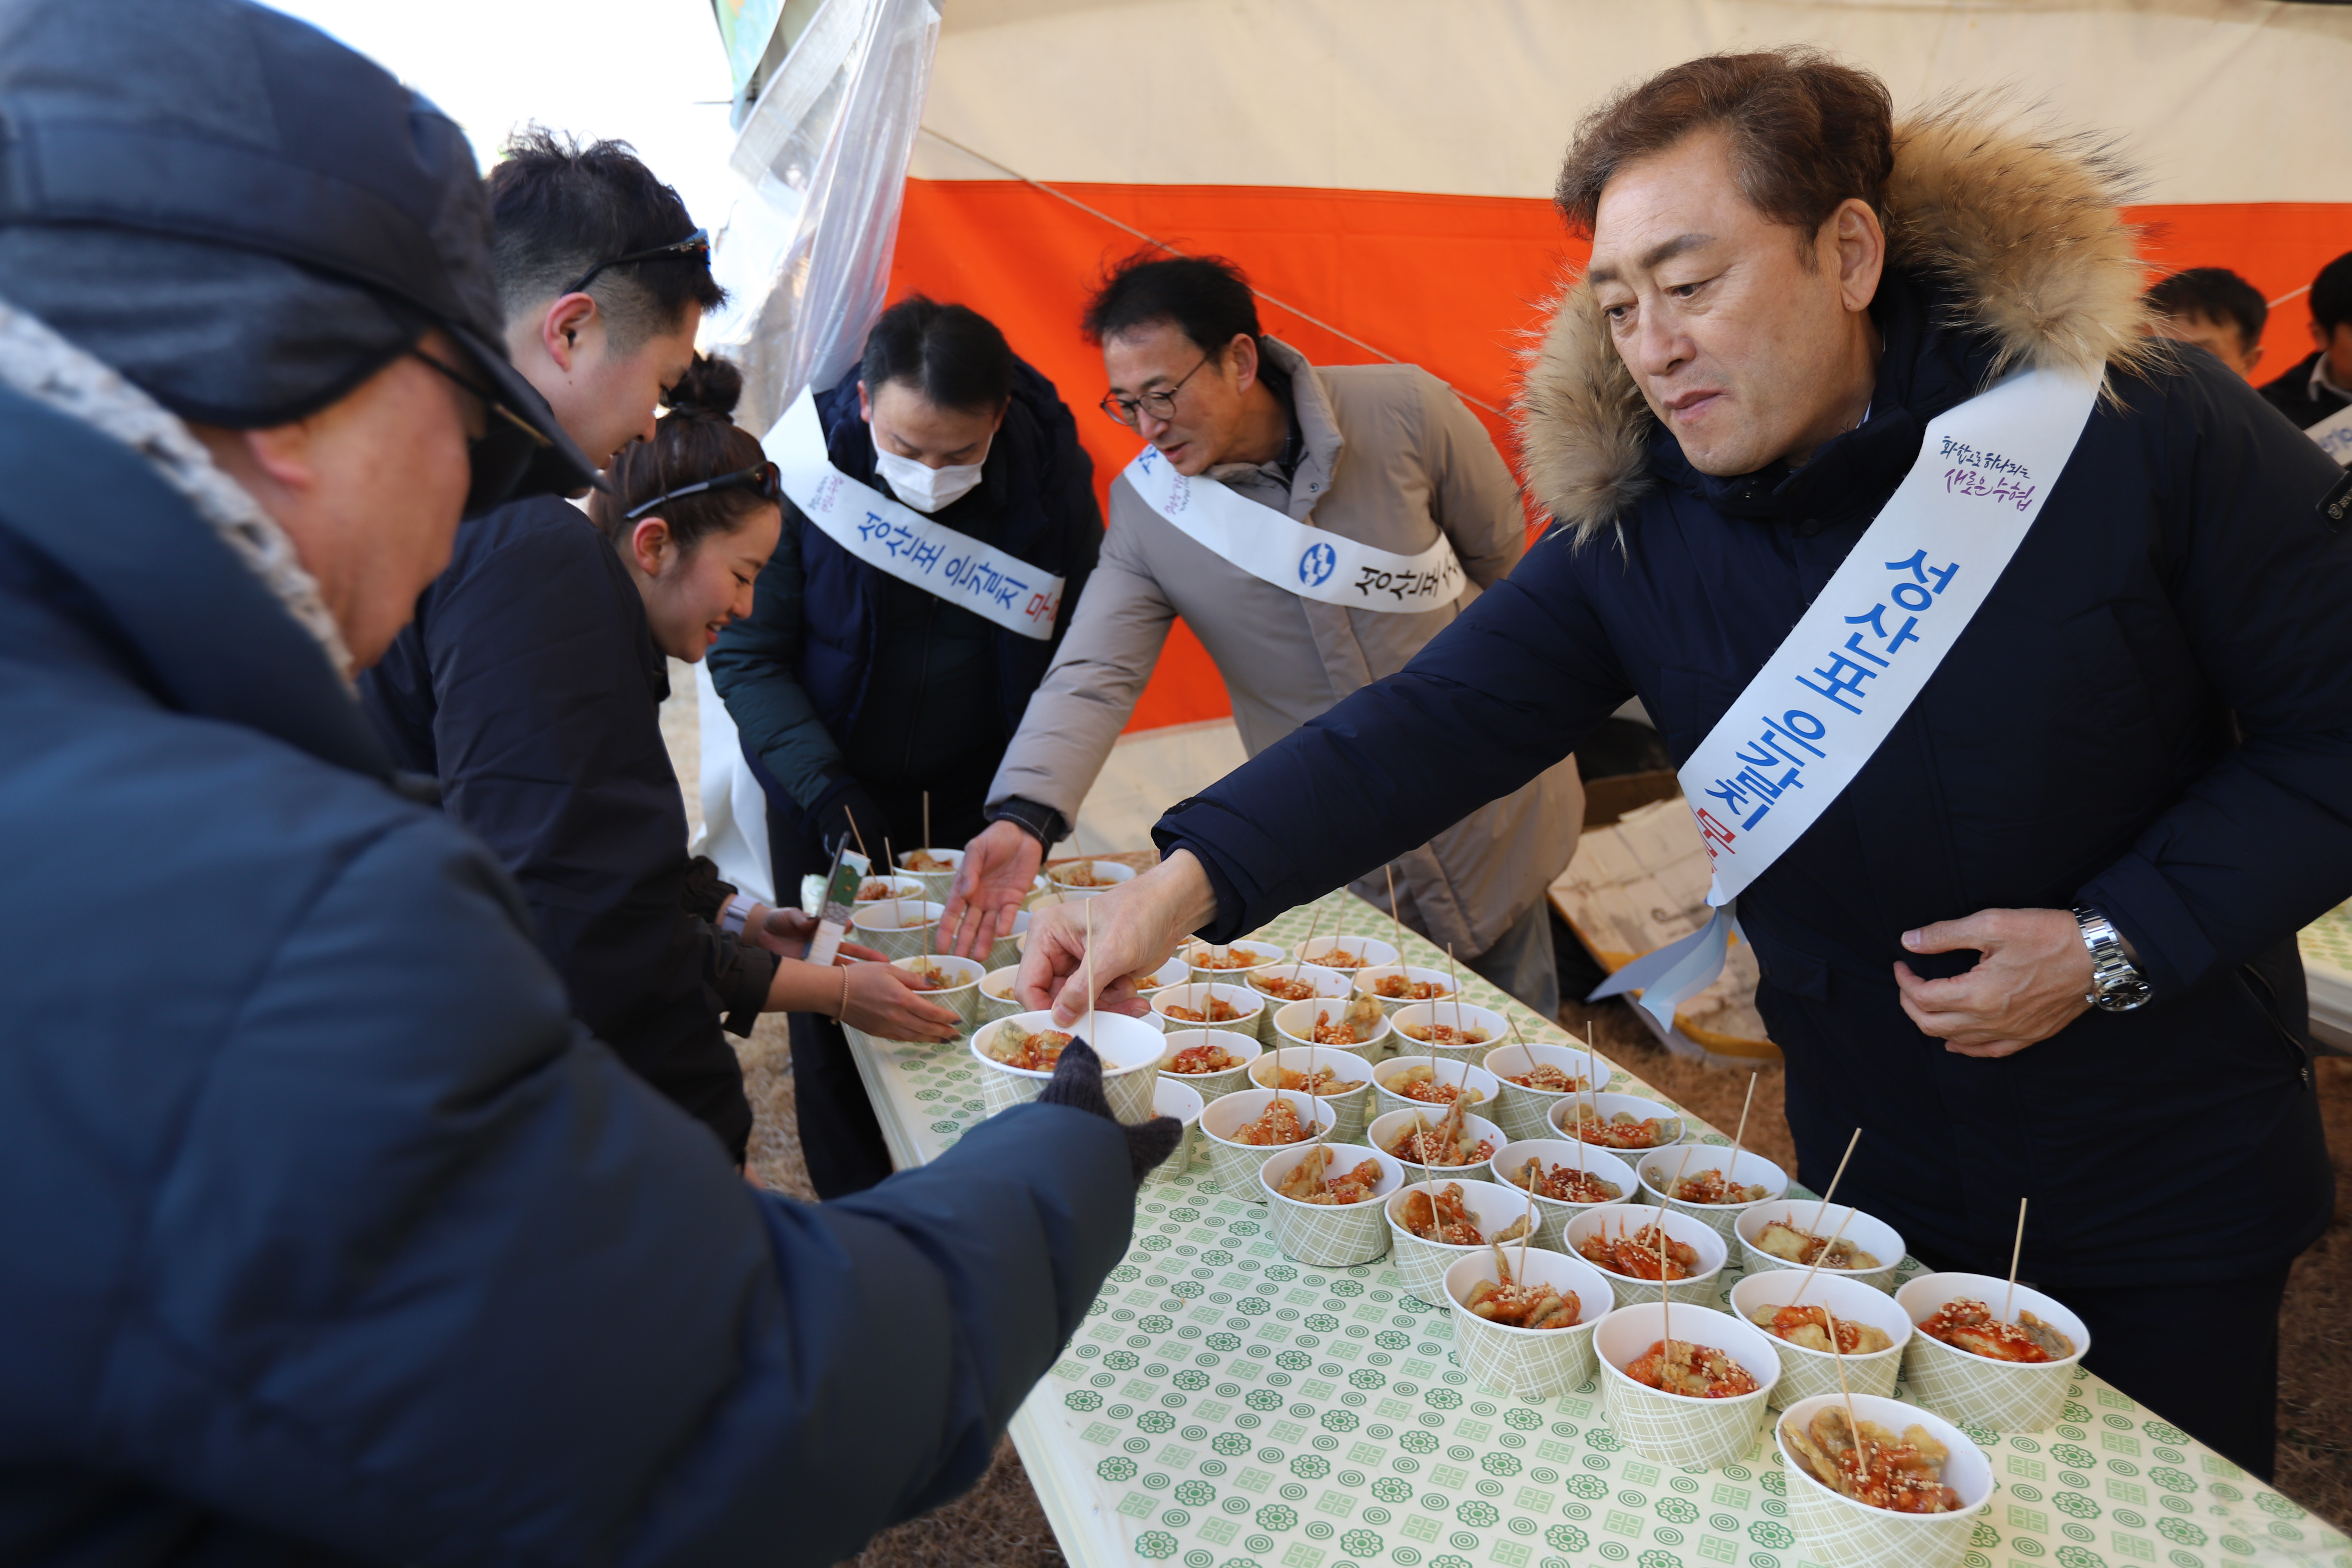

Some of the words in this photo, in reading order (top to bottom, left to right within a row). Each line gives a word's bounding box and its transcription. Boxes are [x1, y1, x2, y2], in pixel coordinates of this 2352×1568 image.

[1940, 435, 1981, 467] 화합으로
[1984, 453, 2030, 479] 하나되는
[1944, 469, 1993, 496] 새로운
[1992, 477, 2035, 511] 수협
[858, 511, 946, 575] 성산포
[945, 556, 1029, 609] 은갈치
[1795, 549, 1960, 715] 성산포
[1704, 709, 1827, 831] 은갈치
